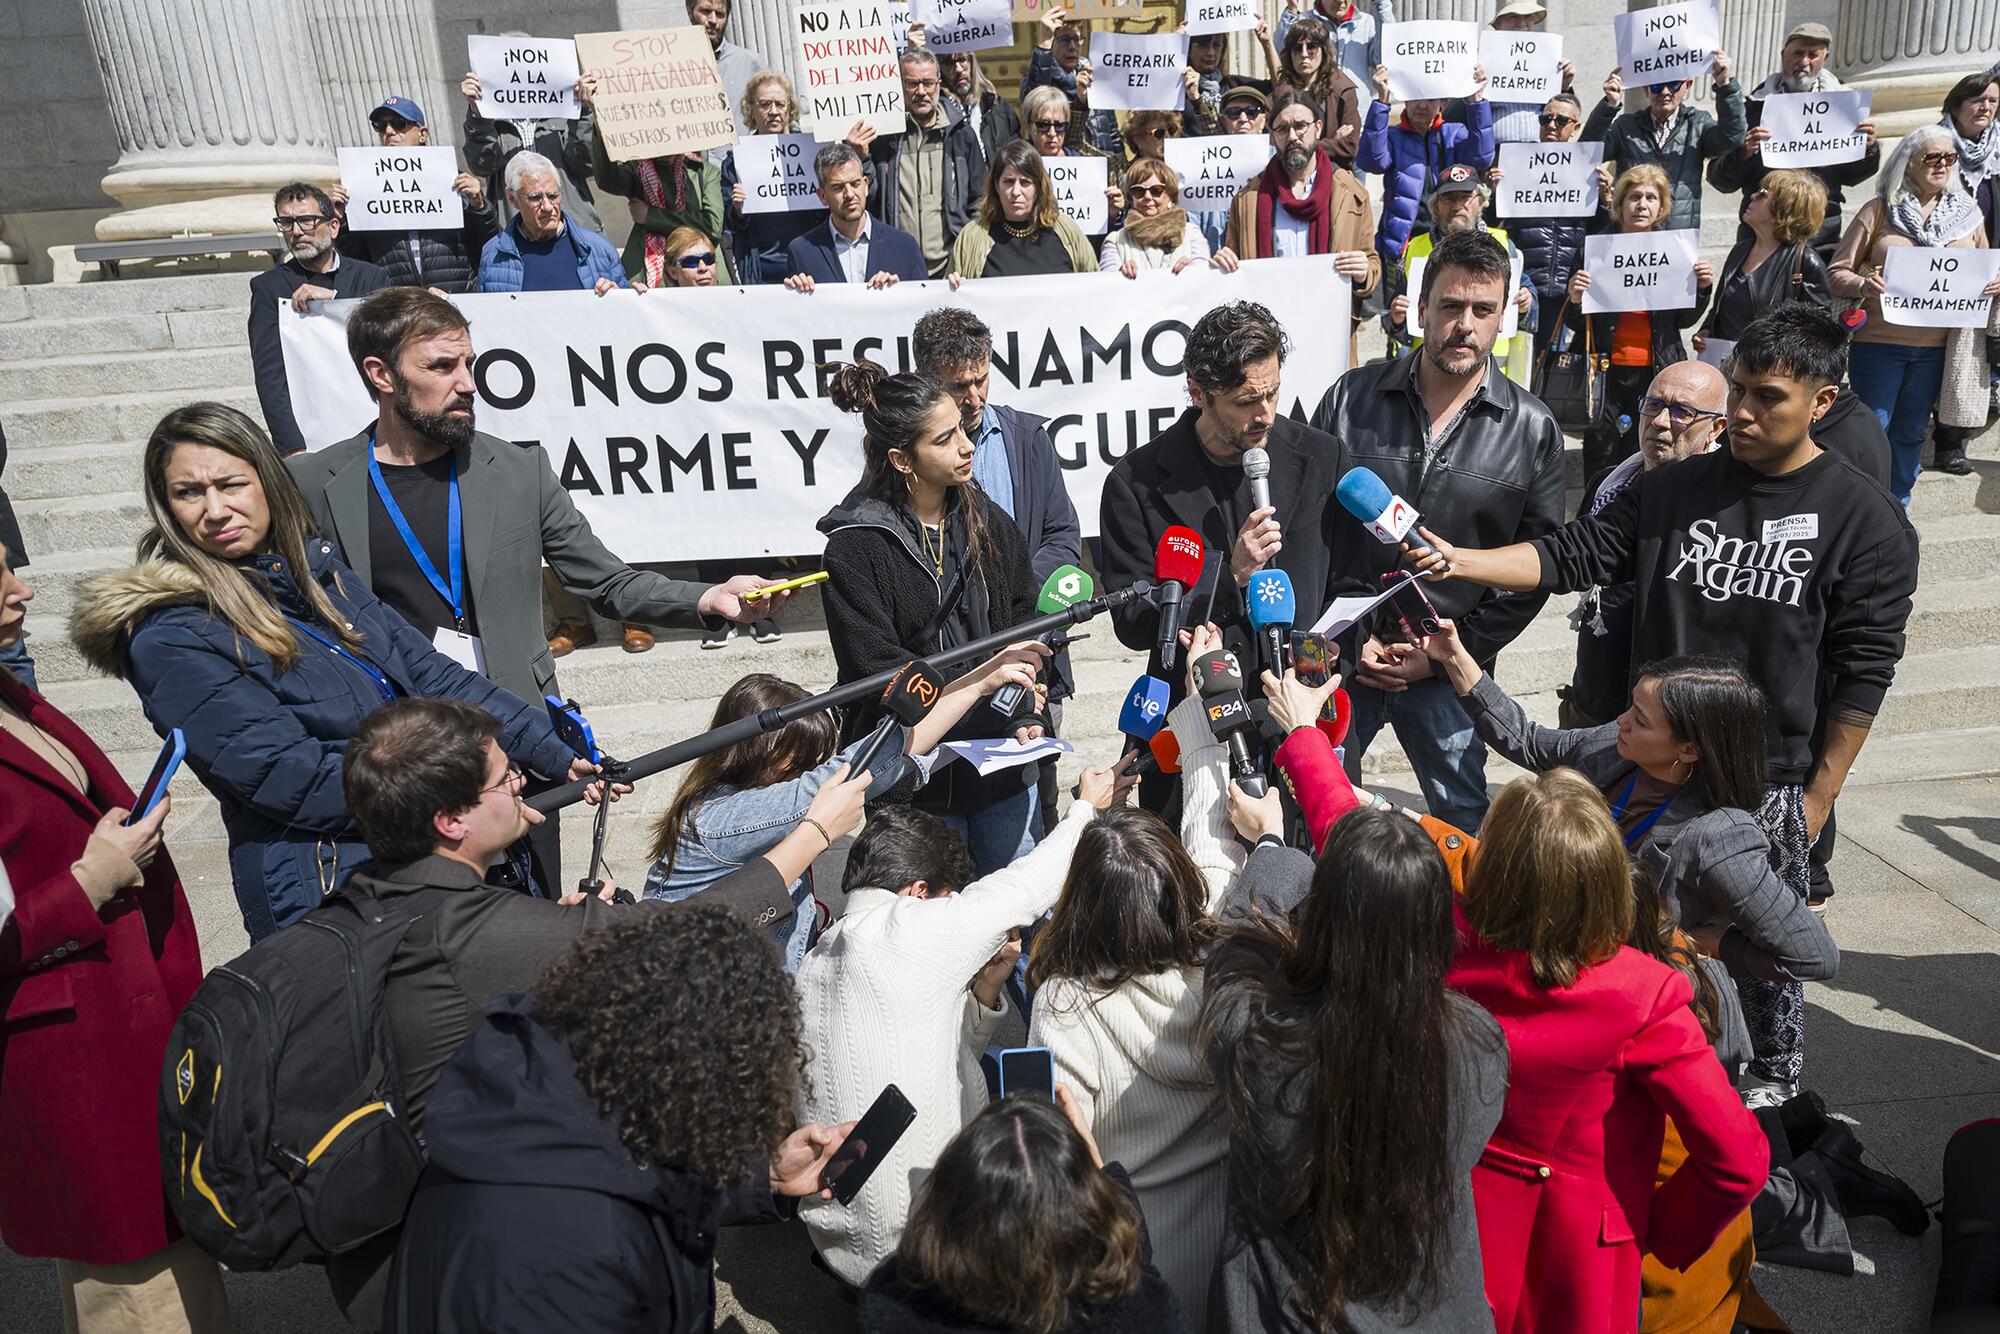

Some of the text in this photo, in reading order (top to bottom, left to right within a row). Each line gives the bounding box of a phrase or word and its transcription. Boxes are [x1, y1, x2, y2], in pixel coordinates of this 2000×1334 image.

[1199, 3, 1248, 20] REARME
[800, 7, 881, 33] NO A LA
[1645, 13, 1688, 37] ¡NON
[932, 24, 995, 45] GUERRA!
[612, 32, 678, 65] STOP
[803, 36, 890, 61] DOCTRINA
[1396, 40, 1468, 57] GERRARIK
[1510, 41, 1536, 57] ¡NO
[1658, 35, 1677, 51] AL
[504, 48, 549, 67] ¡NON
[1102, 53, 1176, 68] GERRARIK
[1514, 59, 1529, 72] AL
[1634, 49, 1703, 73] REARME!
[1425, 60, 1445, 74] EZ!
[510, 70, 547, 84] A LA
[590, 57, 718, 96] PROPAGANDA
[809, 63, 899, 88] DEL SHOCK
[1128, 73, 1149, 87] EZ!
[1491, 76, 1548, 91] REARME!
[494, 90, 564, 104] GUERRA!
[597, 98, 665, 122] VUESTRAS
[814, 91, 903, 120] MILITAR
[1802, 101, 1829, 116] NO
[1804, 121, 1823, 134] AL
[605, 127, 671, 148] NUESTROS
[1764, 135, 1864, 154] REARMAMENT!
[771, 144, 800, 162] ¡NO
[1202, 146, 1232, 164] ¡NO
[1529, 152, 1572, 170] ¡NON
[375, 158, 423, 176] ¡NON
[771, 163, 806, 178] A LA
[1049, 168, 1077, 181] ON
[1200, 166, 1235, 180] A LA
[383, 178, 422, 194] A LA
[1539, 172, 1558, 185] AL
[1057, 187, 1074, 200] LA
[1184, 185, 1242, 199] GUERR
[1514, 190, 1580, 204] REARME!
[367, 199, 443, 214] GUERRA!
[1614, 252, 1670, 269] BAKEA
[1929, 258, 1959, 272] NO
[1623, 272, 1658, 288] BAI!
[1929, 279, 1950, 292] AL
[1884, 295, 1988, 311] REARMAMENT!
[474, 348, 536, 410] O
[566, 341, 733, 408] NOS
[781, 428, 830, 486] Y
[1771, 517, 1808, 530] PRENSA
[1168, 536, 1200, 551] europa
[1173, 544, 1199, 559] press
[1688, 518, 1814, 578] Smile
[1665, 543, 1804, 607] Again
[1047, 591, 1073, 608] laSext
[1133, 691, 1161, 717] tve
